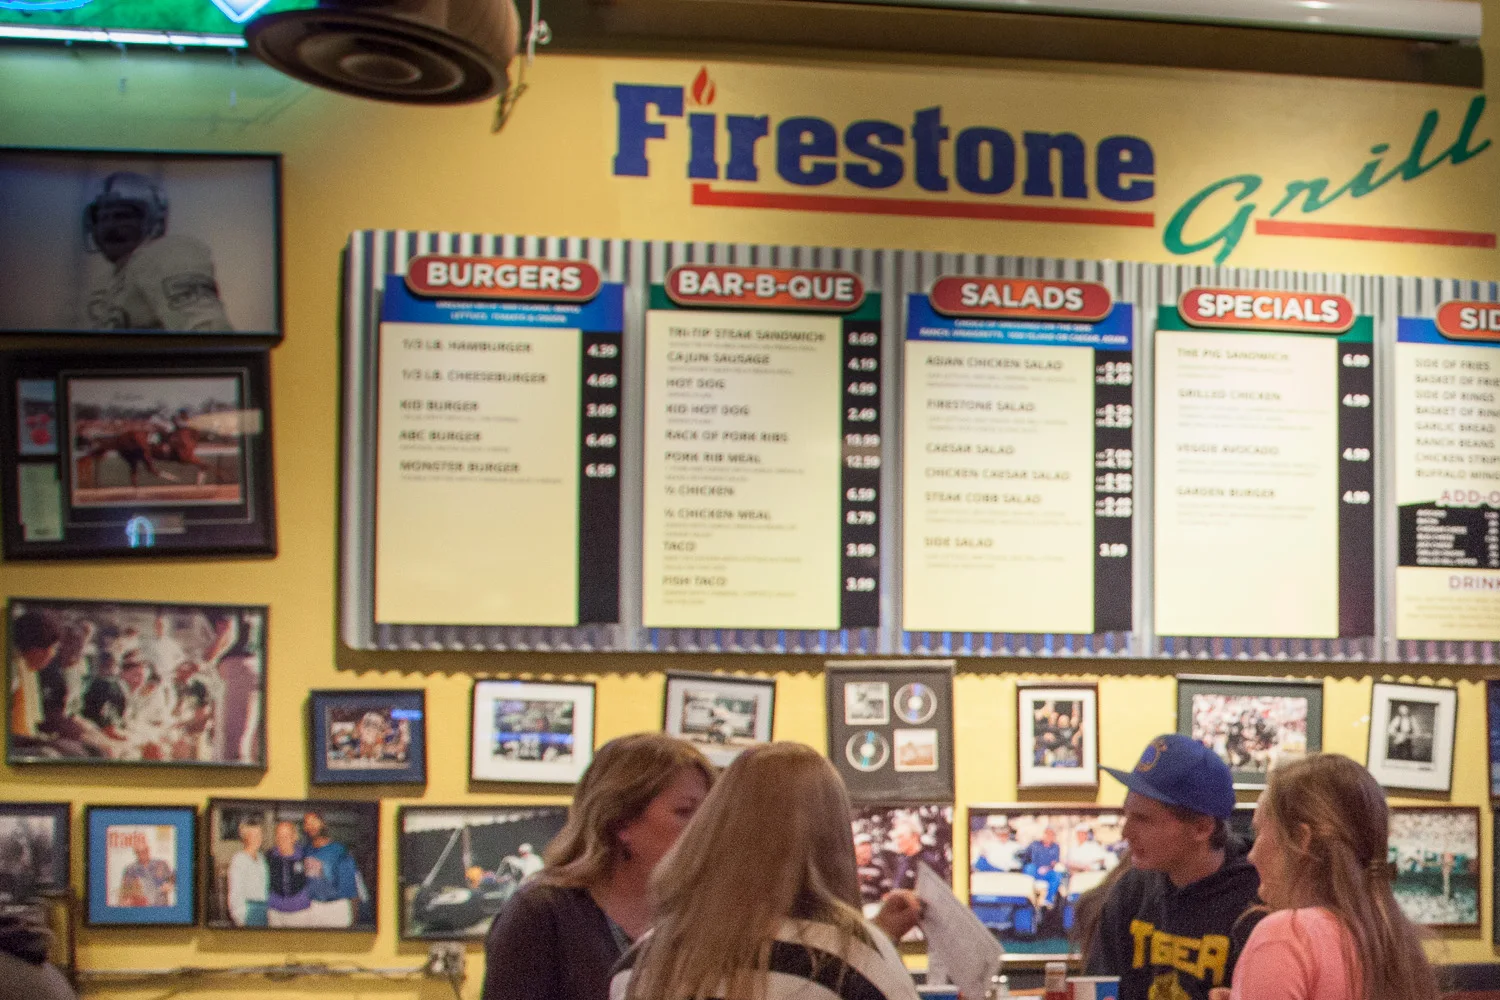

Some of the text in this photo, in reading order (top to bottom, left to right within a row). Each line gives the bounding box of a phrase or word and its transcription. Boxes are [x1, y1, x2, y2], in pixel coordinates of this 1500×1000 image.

[612, 82, 1494, 265] Firestone Grill
[426, 261, 582, 291] BURGERS
[678, 269, 855, 302] BAR-B-QUE
[961, 281, 1084, 311] SALADS
[1197, 292, 1340, 323] SPECIALS
[715, 328, 753, 340] STEAK
[756, 329, 826, 343] SANDWICH
[448, 340, 533, 353] HAMBURGER
[667, 352, 770, 366] CAJUN SAUSAGE
[1226, 349, 1290, 361] SANDWICH
[926, 355, 1063, 370] ASIAN CHICKEN SALAD
[1460, 360, 1491, 372] FRIES
[447, 371, 547, 384] CHEESEBURGER
[667, 378, 726, 390] HOT DOG
[1230, 389, 1281, 401] CHICKEN
[1459, 391, 1496, 403] RINGS
[426, 400, 479, 413] BURGER
[691, 404, 718, 415] HOT
[721, 405, 750, 416] DOG
[927, 399, 1036, 413] FIRESTONE SALAD
[1459, 422, 1496, 434] BREAD
[428, 431, 481, 443] BURGER
[722, 432, 758, 443] PORK
[926, 443, 1015, 456] CAESAR SALAD
[1223, 444, 1280, 456] AVOCADO
[1459, 438, 1496, 450] BEANS
[664, 451, 699, 462] PORK
[728, 453, 761, 464] MEAL
[1415, 453, 1465, 465] CHICKEN
[399, 460, 520, 474] MONSTER BURGER
[925, 467, 1071, 482] CHICKEN CAESAR SALAD
[1416, 468, 1468, 480] BUFFALO
[678, 486, 735, 498] CHICKEN
[1229, 487, 1276, 499] BURGER
[925, 492, 961, 503] STEAK
[1003, 494, 1042, 505] SALAD
[678, 508, 734, 520] CHICKEN
[737, 510, 772, 522] MEAL
[663, 541, 697, 553] TACO
[955, 537, 994, 549] SALAD
[694, 576, 727, 588] TACO
